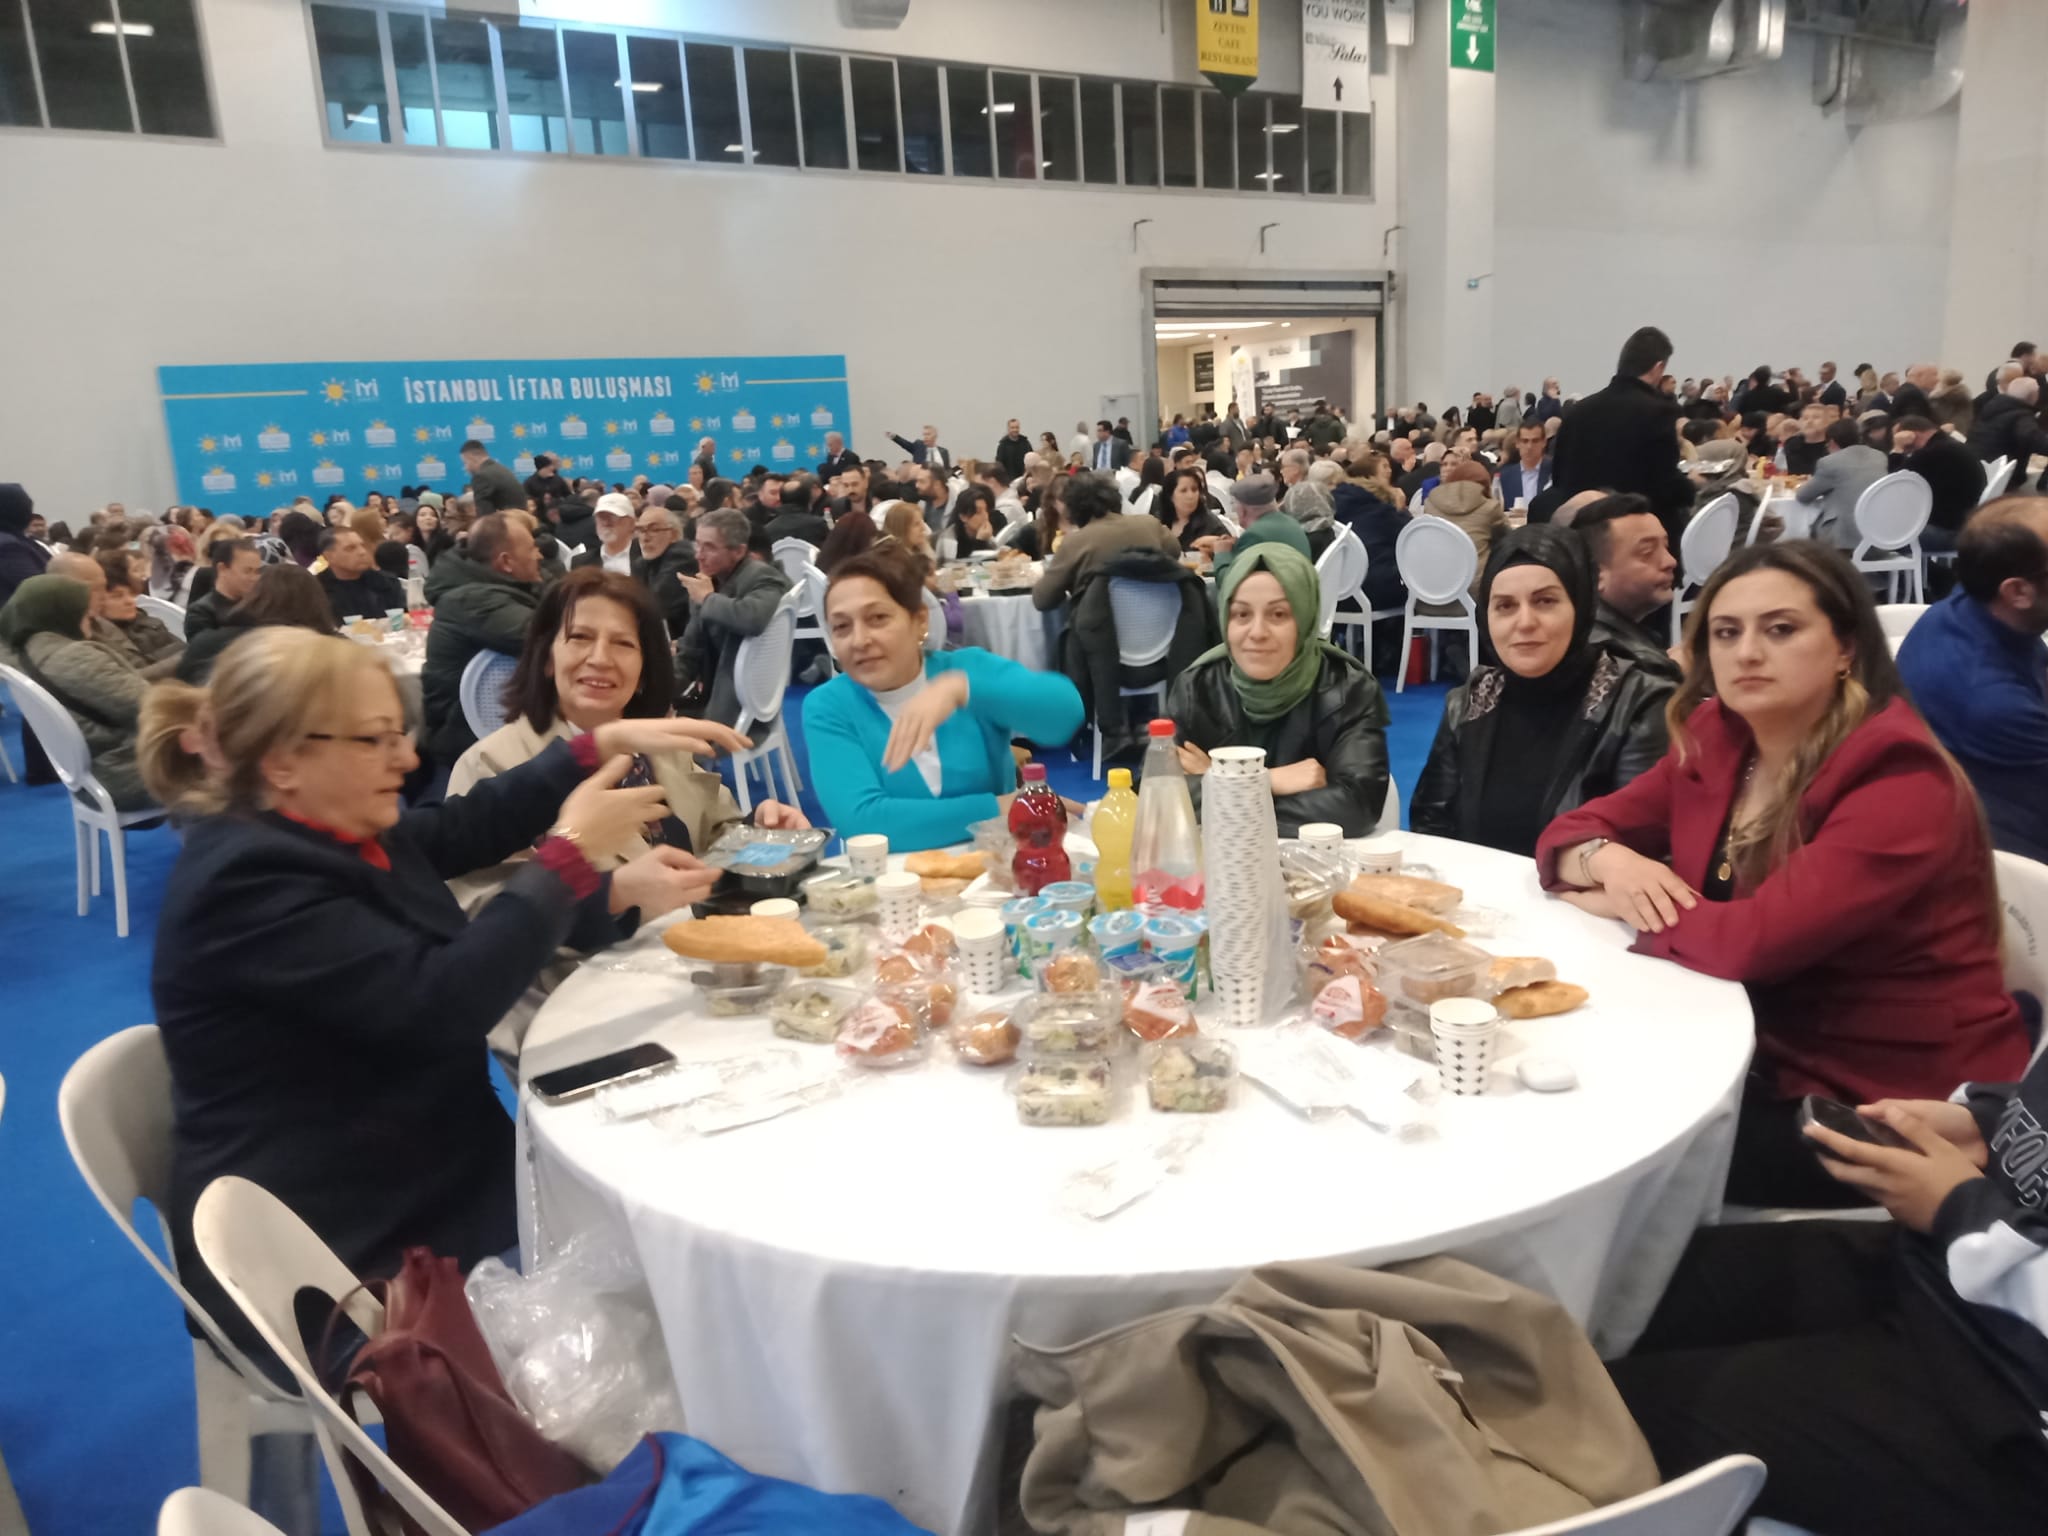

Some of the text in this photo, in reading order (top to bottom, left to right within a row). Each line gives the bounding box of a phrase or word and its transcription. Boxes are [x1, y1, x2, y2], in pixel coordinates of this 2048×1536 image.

[1305, 3, 1329, 19] YOU
[1332, 7, 1367, 23] WORK
[1200, 50, 1257, 66] RESTAURANT
[403, 374, 672, 404] İSTANBUL İFTAR BULUŞMASI
